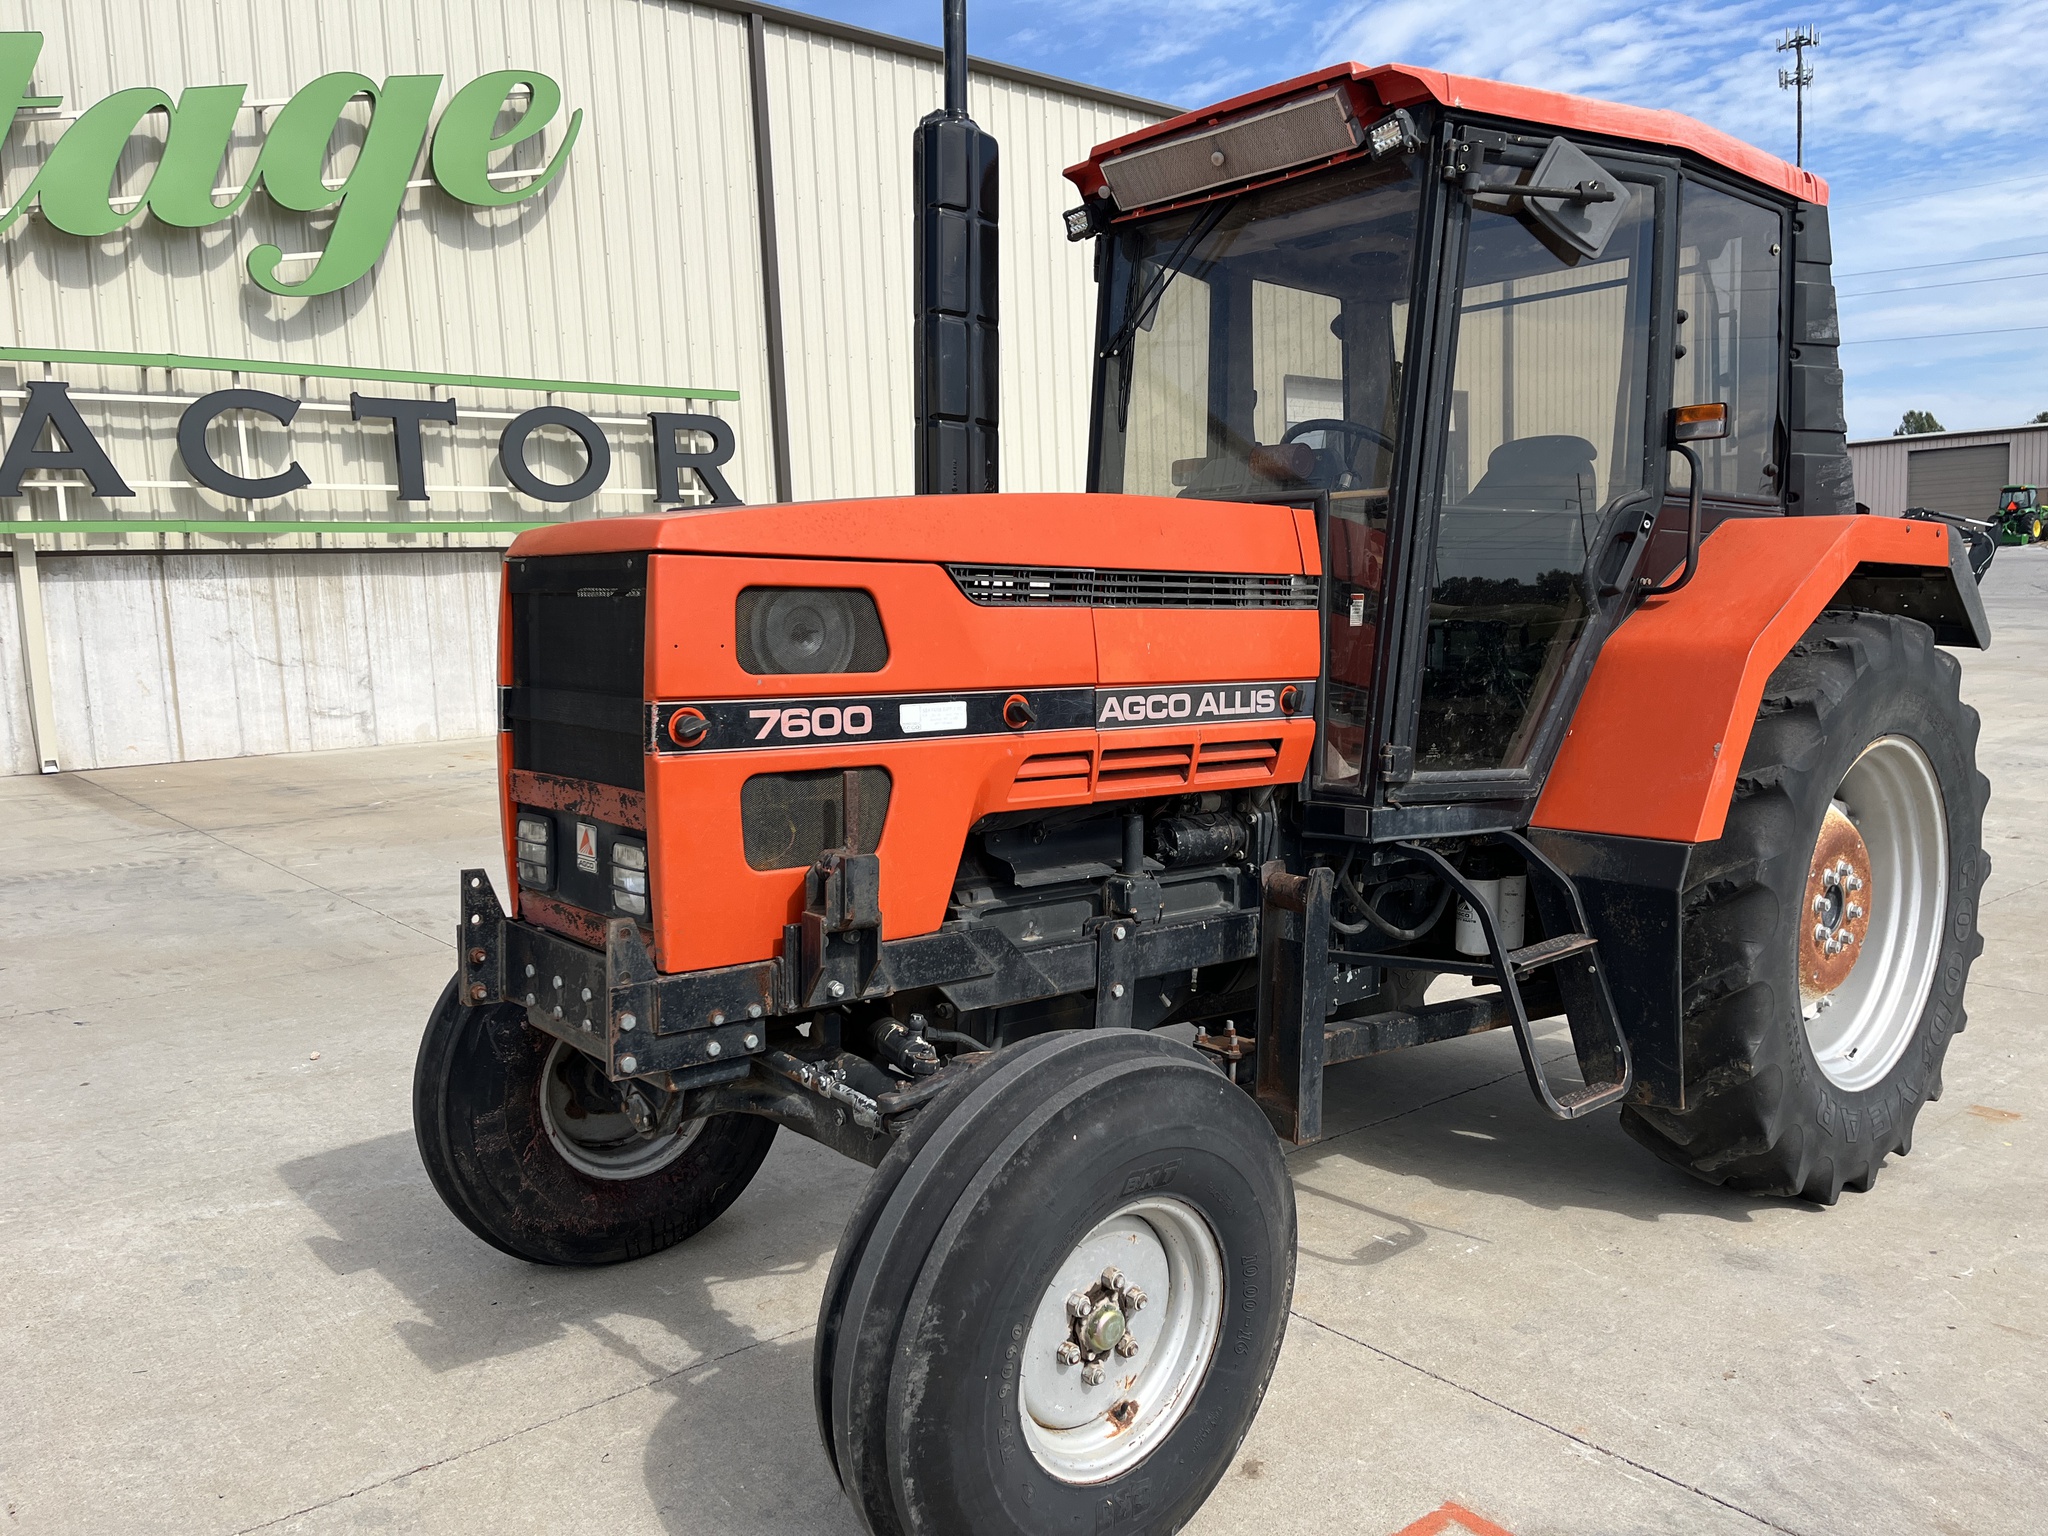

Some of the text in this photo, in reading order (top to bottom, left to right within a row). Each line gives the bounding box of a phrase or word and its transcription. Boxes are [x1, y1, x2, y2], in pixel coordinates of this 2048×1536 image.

[0, 380, 744, 506] ACTOR
[749, 705, 873, 740] 7600
[1099, 688, 1277, 723] AGCO ALLIS
